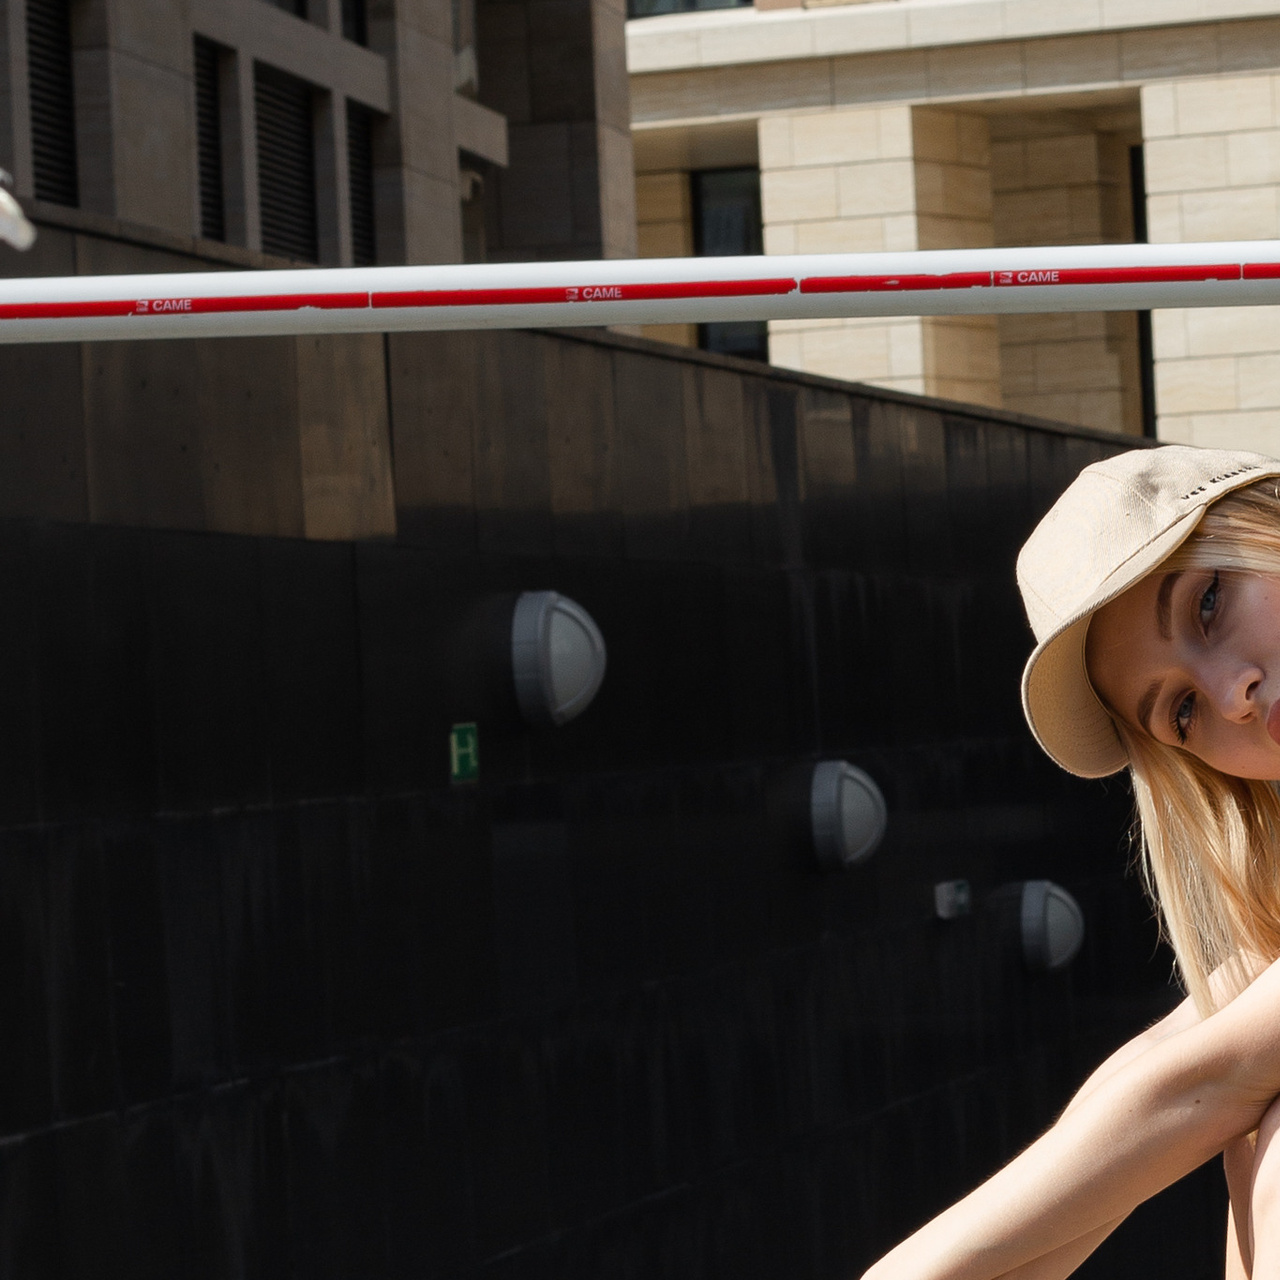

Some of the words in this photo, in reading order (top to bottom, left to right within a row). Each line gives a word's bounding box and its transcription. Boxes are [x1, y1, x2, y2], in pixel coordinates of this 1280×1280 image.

[1016, 271, 1060, 283] CAME
[582, 287, 623, 299] CAME
[152, 298, 192, 311] CAME
